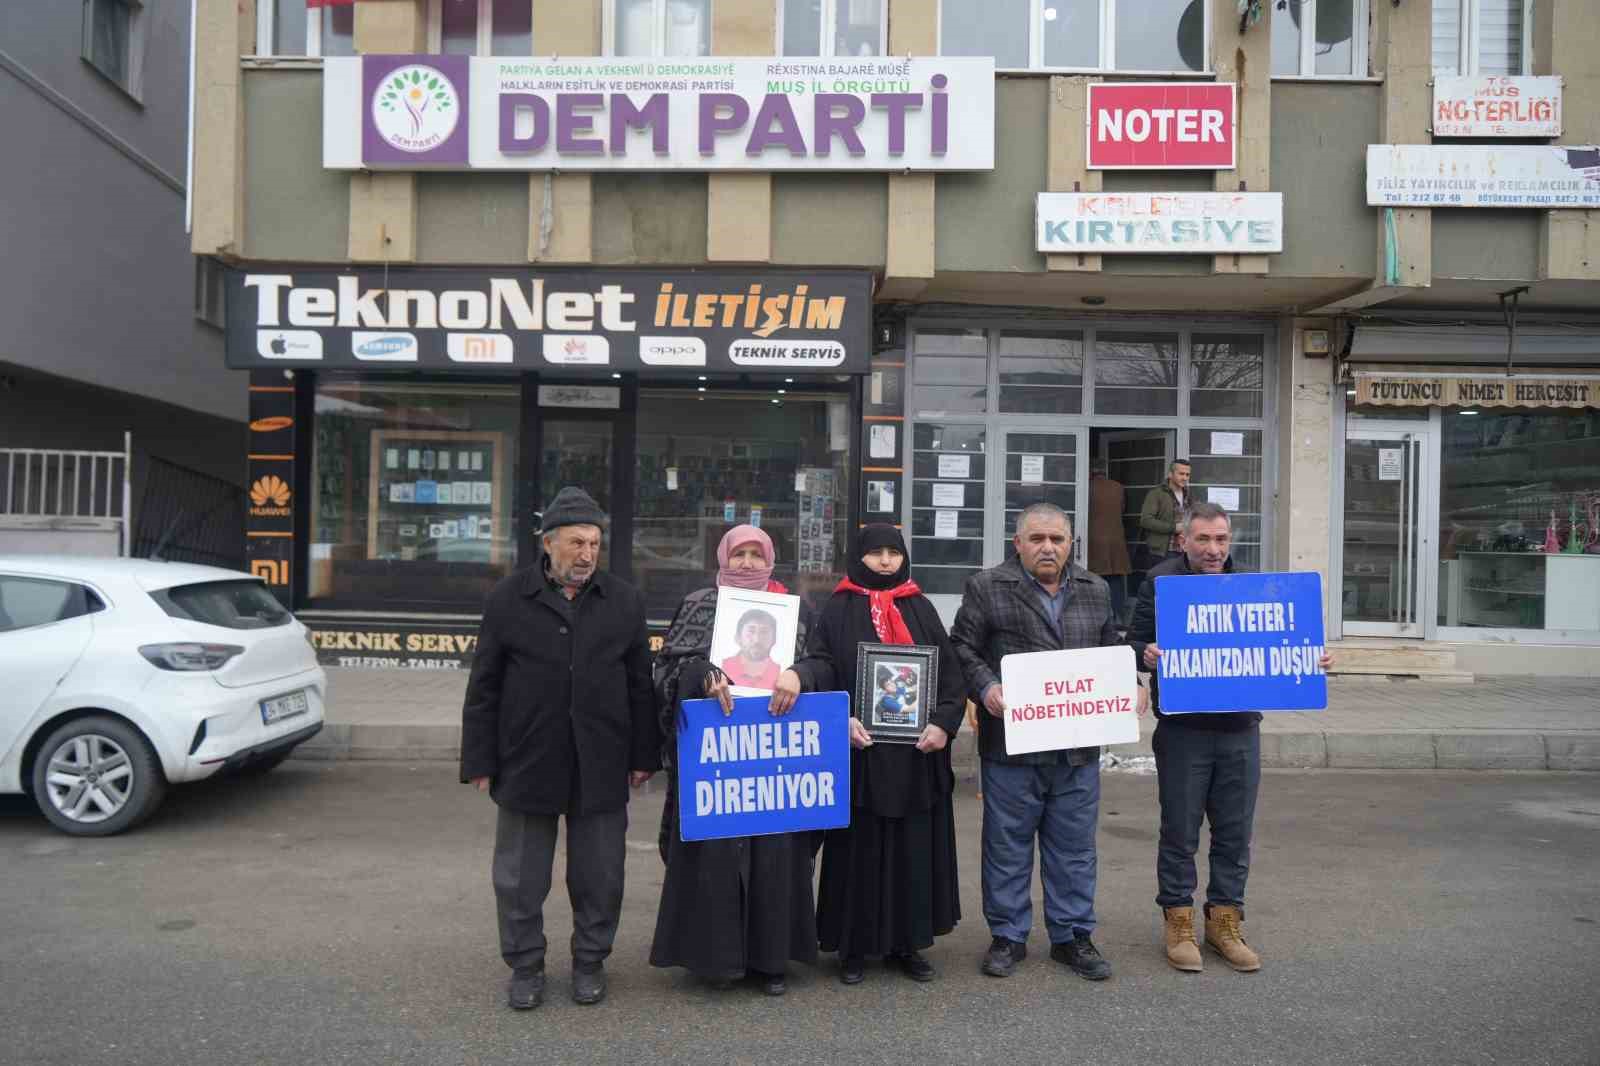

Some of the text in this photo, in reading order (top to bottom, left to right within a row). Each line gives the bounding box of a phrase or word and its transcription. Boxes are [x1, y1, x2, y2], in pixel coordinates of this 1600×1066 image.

[545, 64, 582, 75] GELAN
[585, 64, 594, 75] A
[500, 79, 564, 91] HALKLARIN
[608, 80, 624, 91] VE
[625, 78, 688, 91] DEMOKRASİ
[692, 78, 735, 91] PARTİSİ
[811, 78, 828, 93] İL
[832, 78, 911, 93] ÖRGÜTÜ
[498, 74, 949, 157] DEM PARTİ
[1097, 109, 1226, 142] NOTER
[1044, 217, 1276, 244] KIRTASİYE
[244, 274, 846, 338] TeknoNet İLETİŞİM
[733, 344, 841, 359] TEKNİK SERVİS
[1370, 378, 1442, 399] TÜTÜNCÜ
[1458, 380, 1504, 401] NİMET
[1186, 603, 1235, 634] ARTIK
[1235, 602, 1286, 633] YETER
[1159, 647, 1266, 679] YAKAMIZDAN
[1043, 678, 1095, 696] EVLAT
[1011, 695, 1132, 723] NÖBETİNDEYİZ
[700, 721, 821, 764] ANNELER
[695, 765, 835, 817] DİRENİYOR
